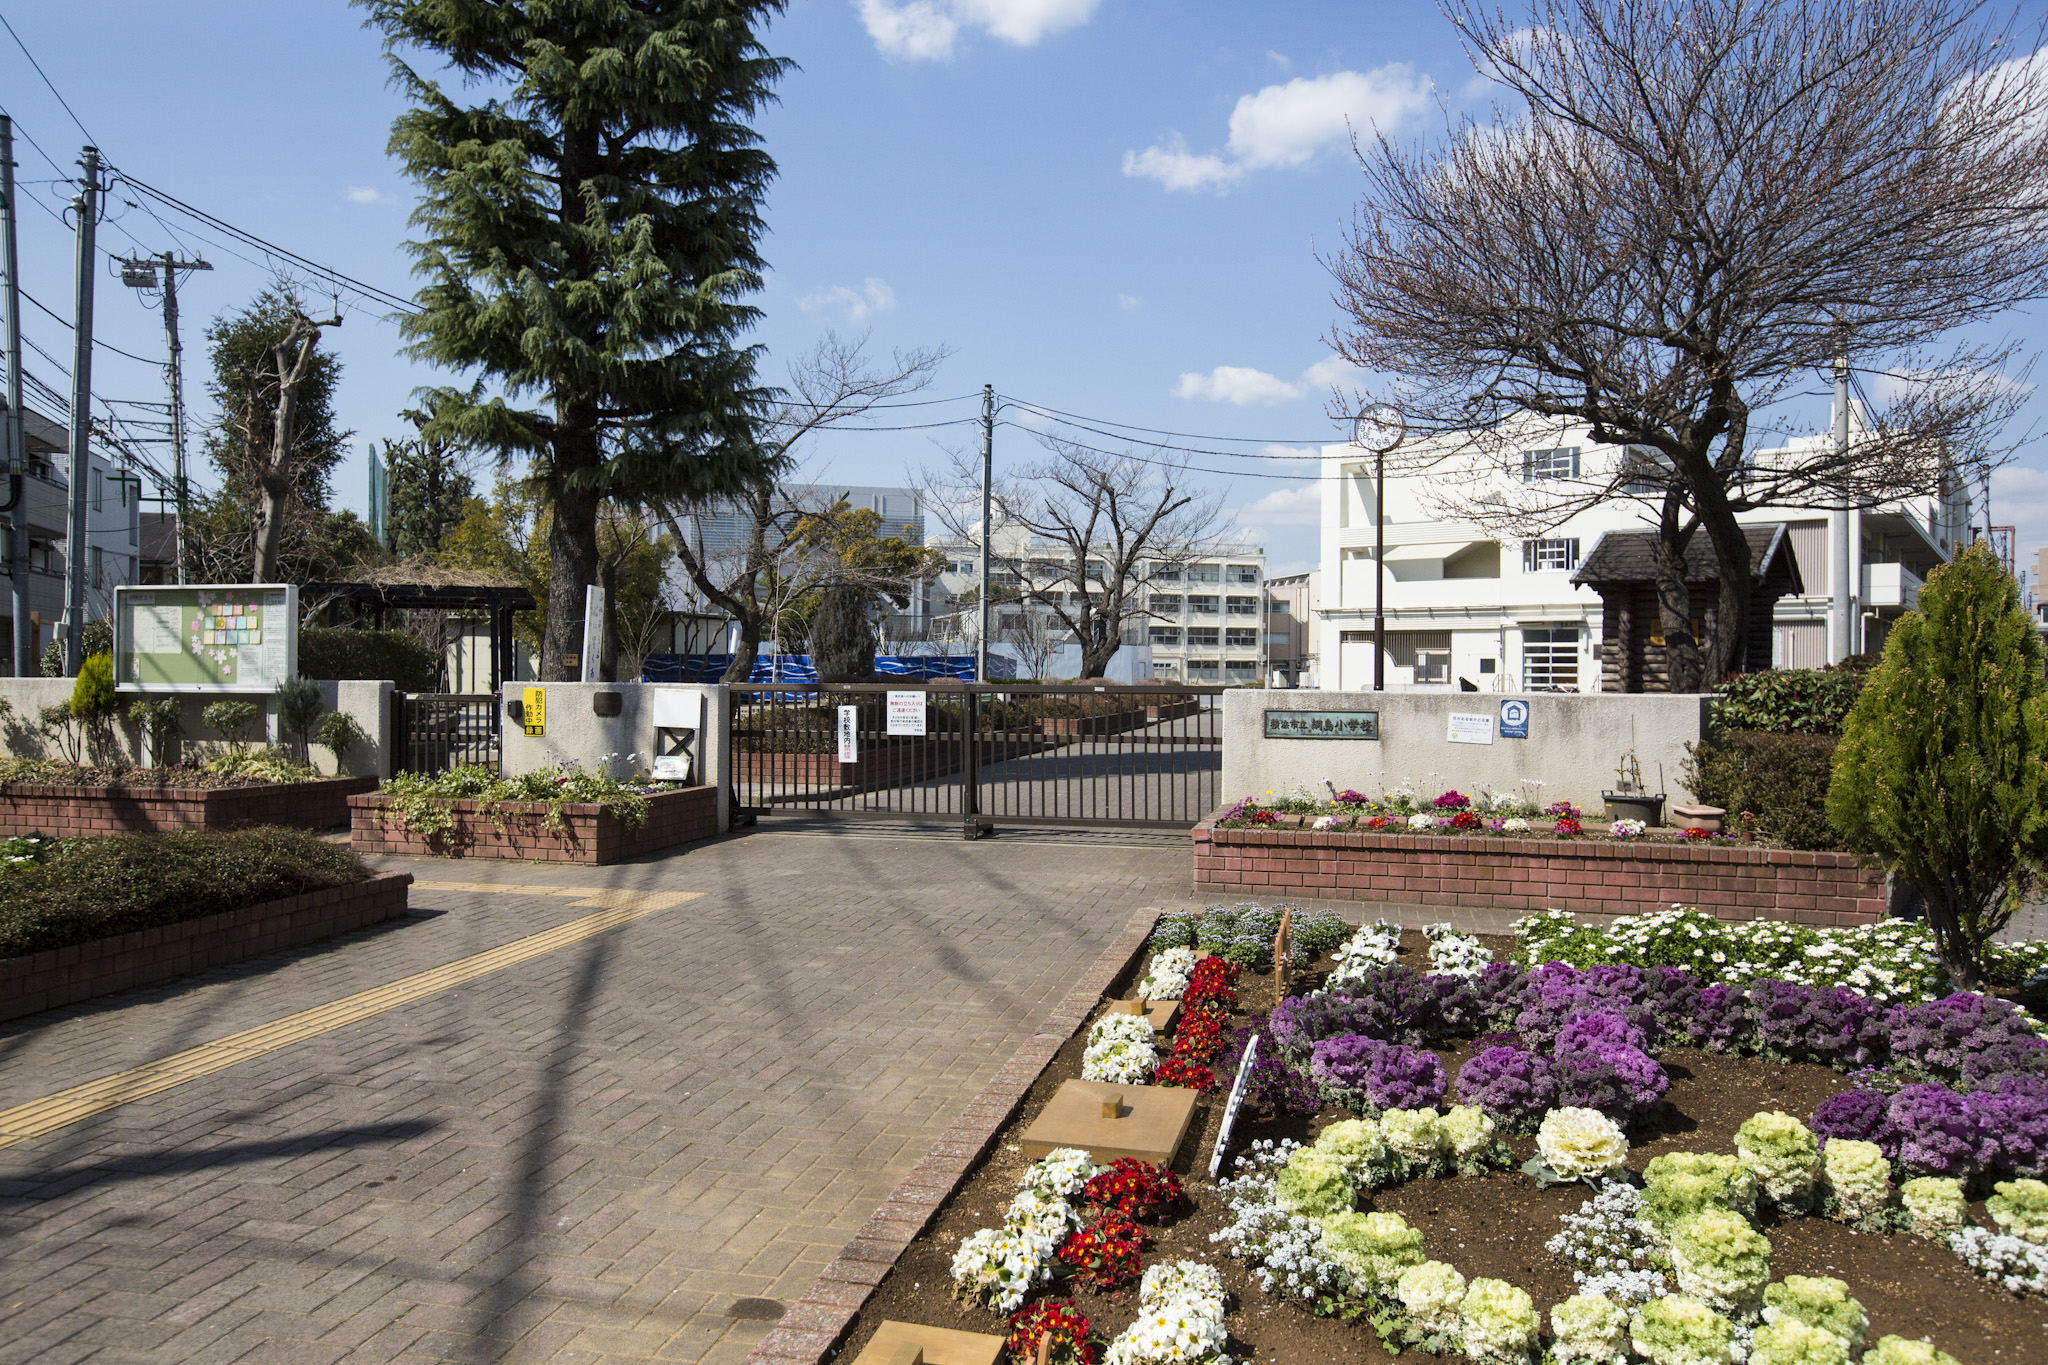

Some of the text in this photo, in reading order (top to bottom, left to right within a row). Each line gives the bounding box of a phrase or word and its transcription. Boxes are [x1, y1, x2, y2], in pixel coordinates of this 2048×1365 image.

[525, 704, 533, 724] 作動中
[535, 690, 543, 724] 防犯カメラ
[843, 709, 851, 759] 学校敷地内禁煙
